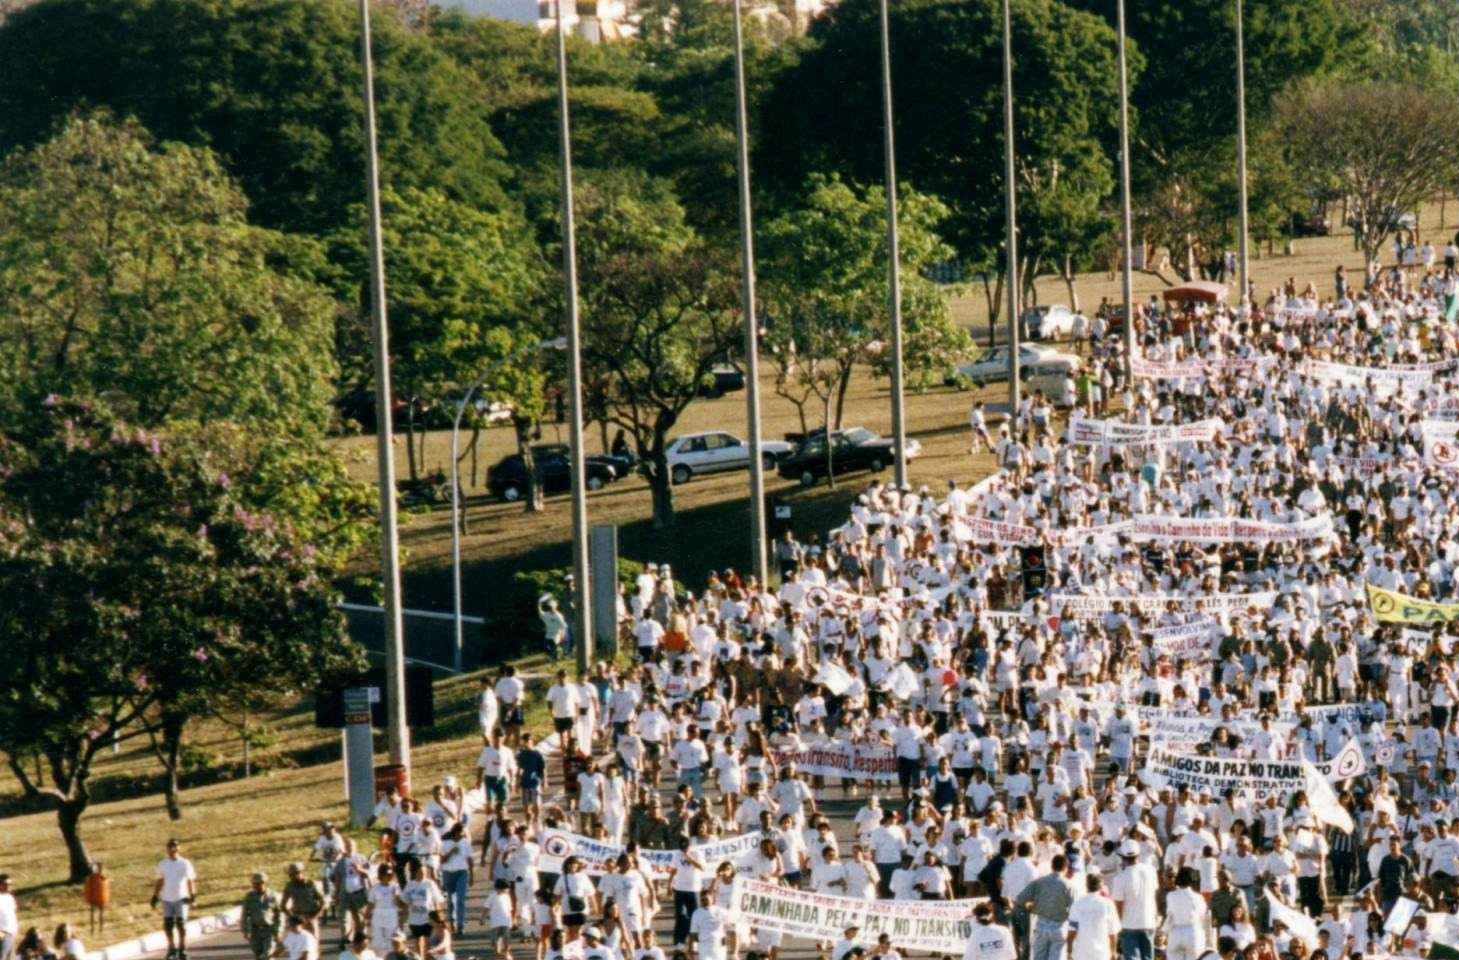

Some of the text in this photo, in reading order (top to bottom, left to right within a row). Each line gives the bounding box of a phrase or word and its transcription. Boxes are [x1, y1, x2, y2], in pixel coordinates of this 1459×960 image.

[1152, 750, 1332, 779] AMIGOS DA PAZ NO TRANTO
[704, 834, 759, 860] RANSITO
[740, 892, 818, 925] CAMINHADA
[865, 913, 887, 933] PAZ
[894, 917, 910, 936] NO
